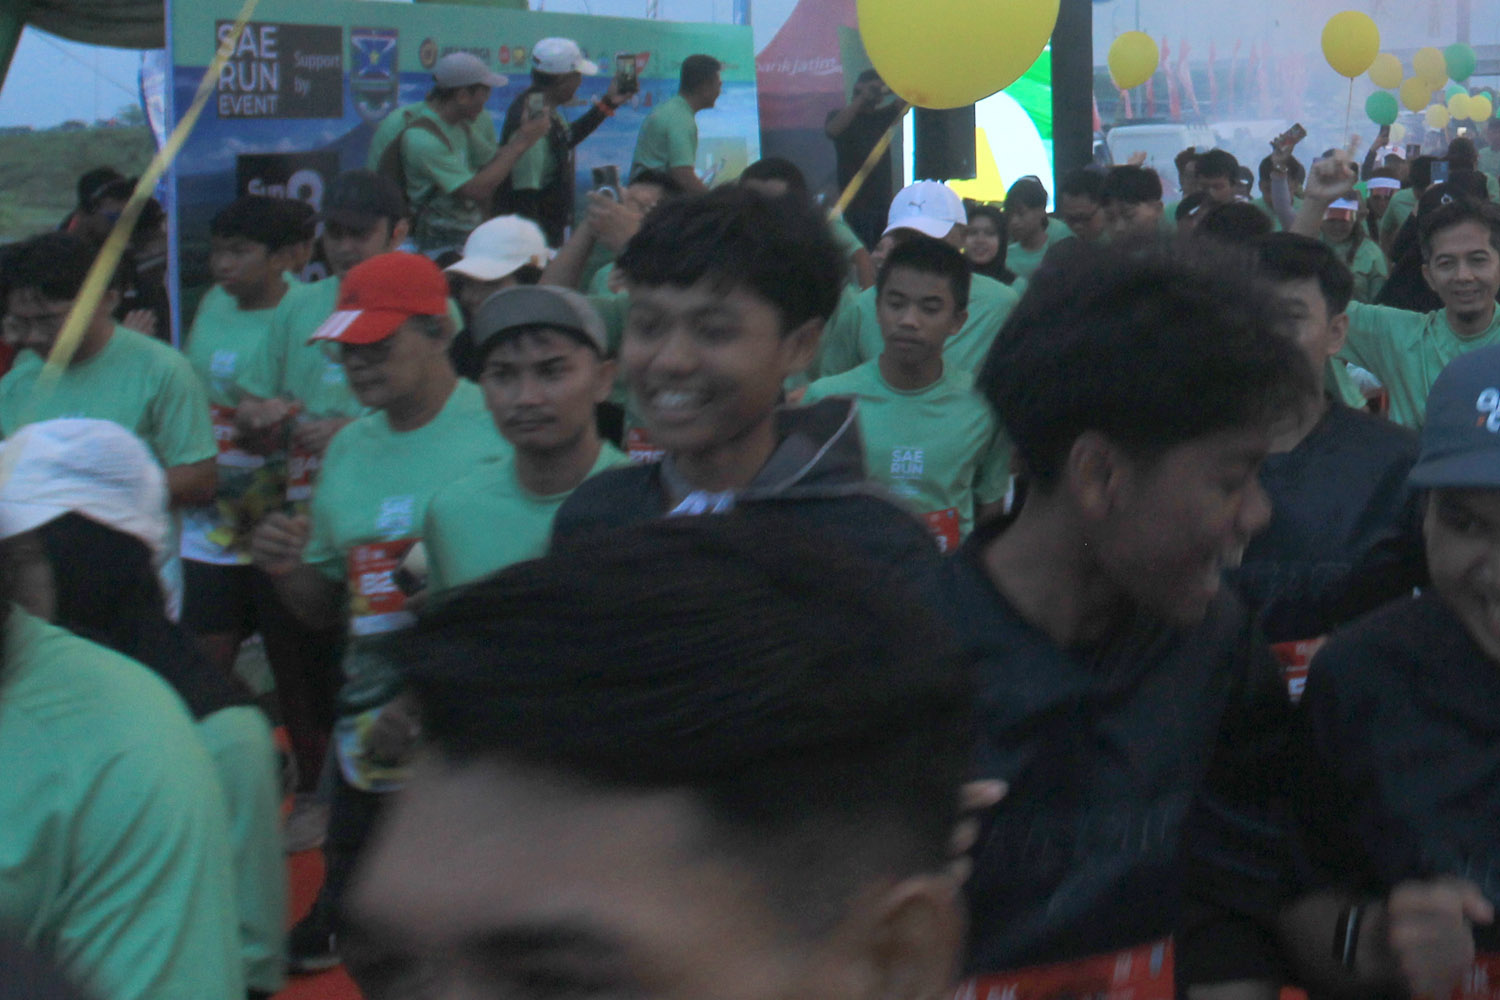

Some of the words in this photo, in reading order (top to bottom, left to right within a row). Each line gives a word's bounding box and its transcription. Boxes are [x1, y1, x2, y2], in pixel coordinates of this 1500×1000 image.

[217, 24, 279, 58] SAE
[293, 51, 341, 70] Support
[218, 60, 279, 92] RUN
[294, 76, 311, 96] by
[219, 93, 278, 116] EVENT
[892, 449, 924, 462] SAE
[890, 462, 924, 474] RUN
